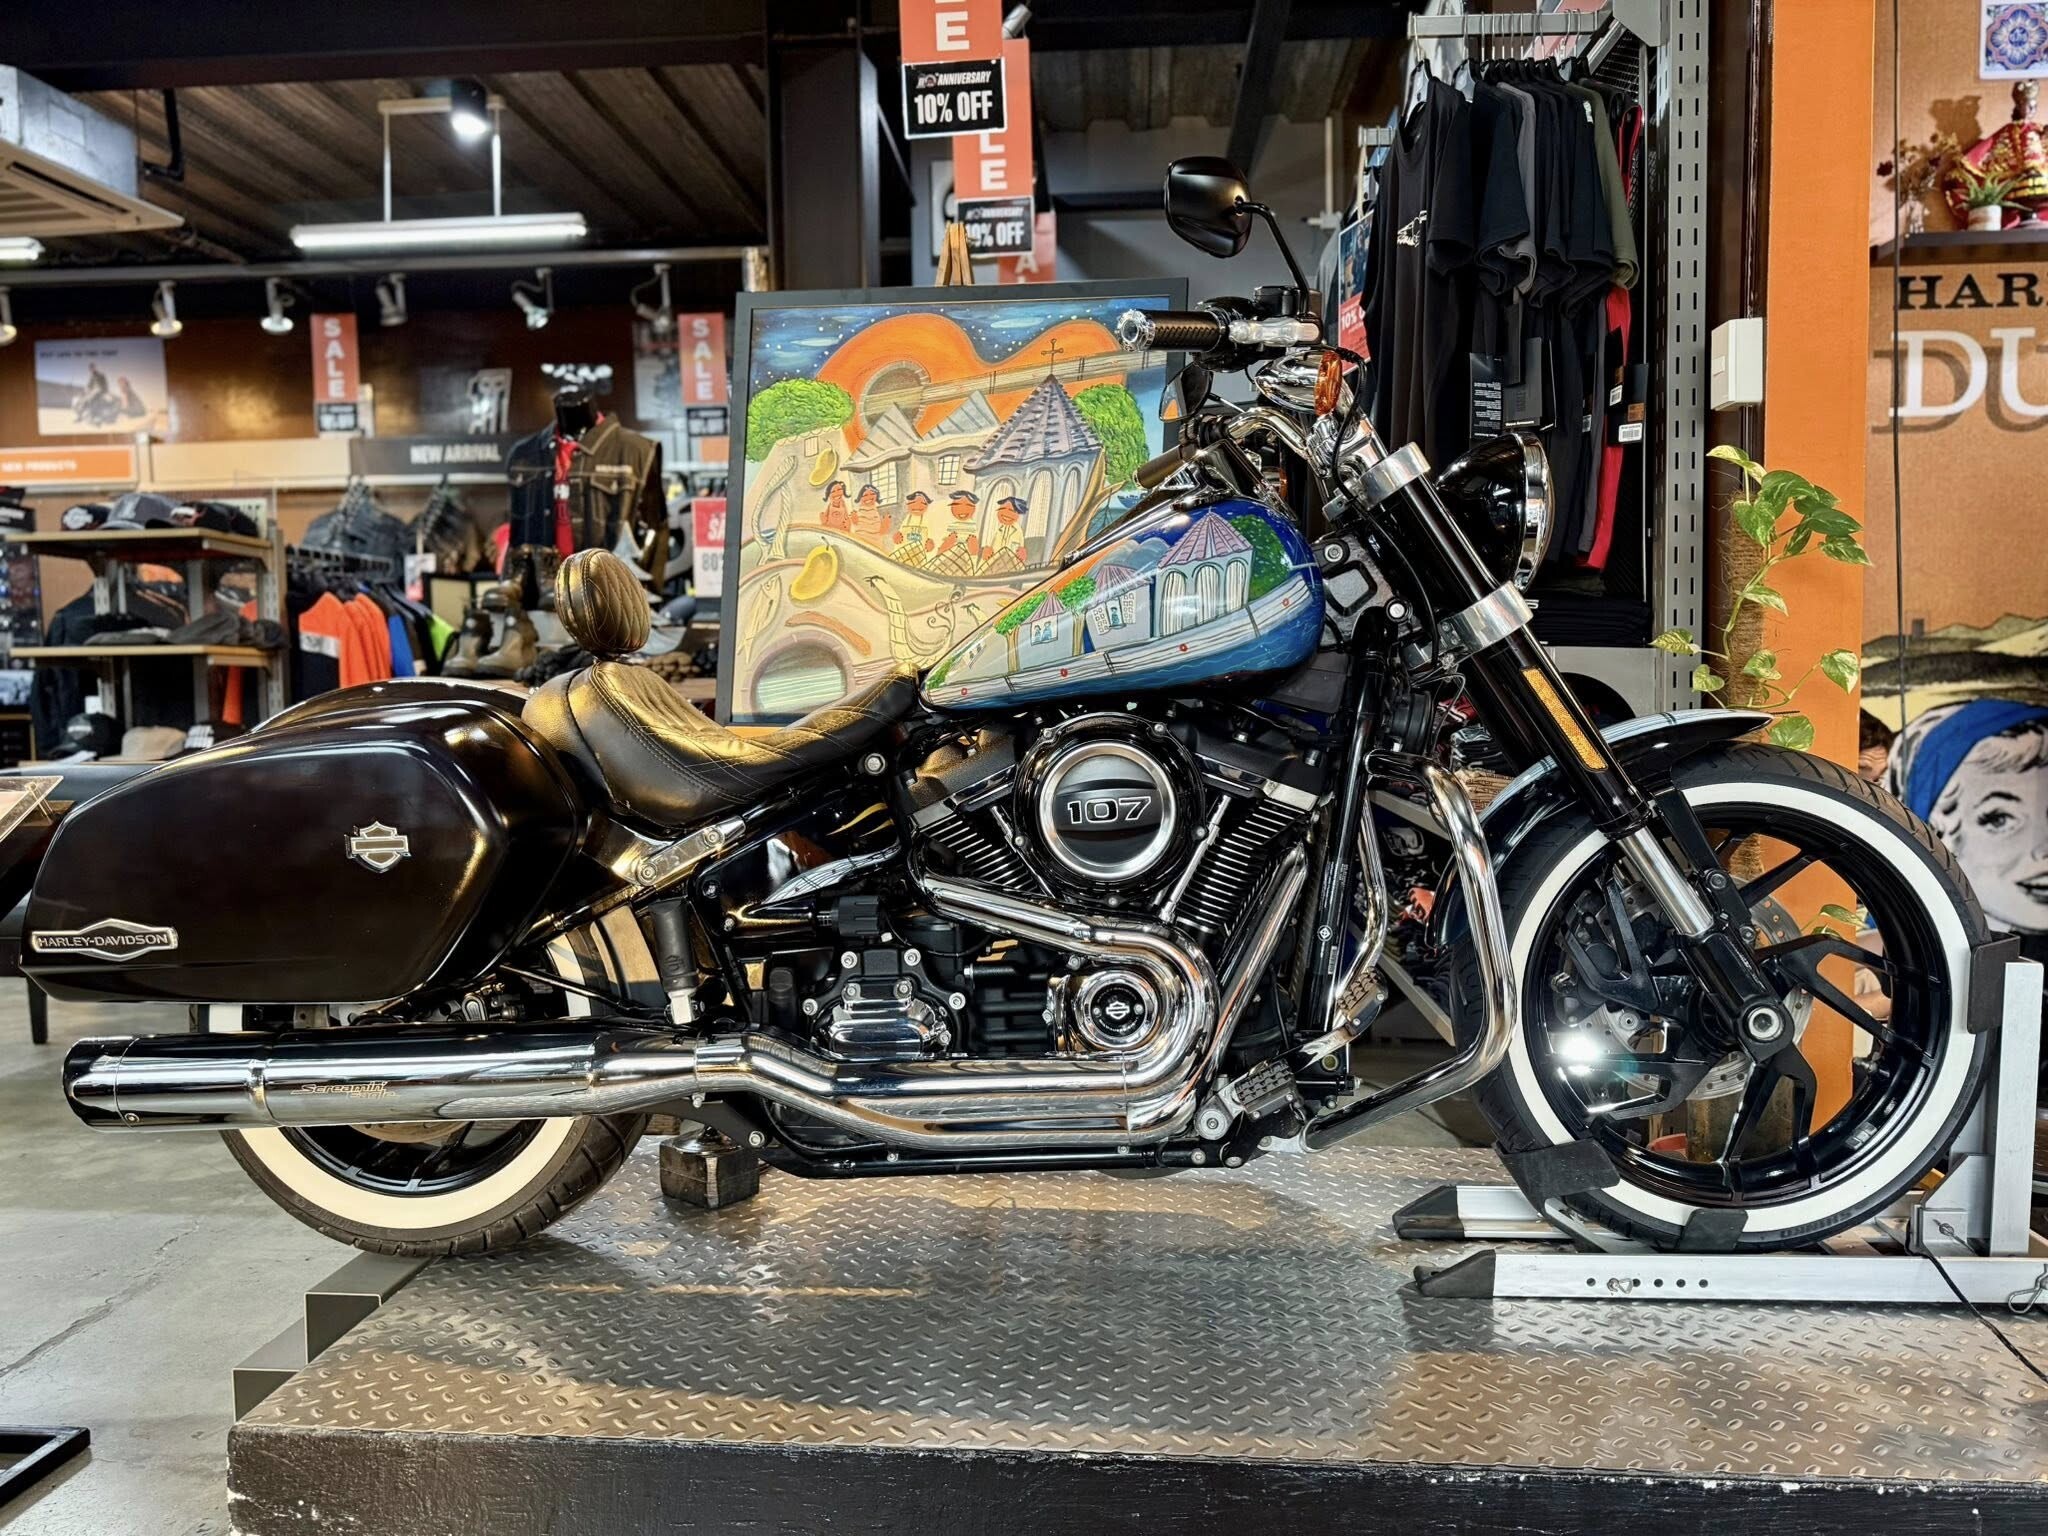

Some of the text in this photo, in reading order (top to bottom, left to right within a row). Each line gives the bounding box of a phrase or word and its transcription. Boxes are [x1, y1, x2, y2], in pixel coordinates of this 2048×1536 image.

[937, 71, 992, 86] ANNIVERSARY
[914, 90, 993, 125] 10% OFF
[996, 222, 1025, 246] OFF
[1896, 272, 2048, 310] HAR
[324, 318, 345, 400] SALE
[692, 319, 714, 401] SALE
[410, 443, 502, 464] NEW ARRIVAL
[702, 553, 724, 571] 80
[1067, 796, 1152, 824] 107
[37, 933, 169, 947] HARLEY-DAVIDSON
